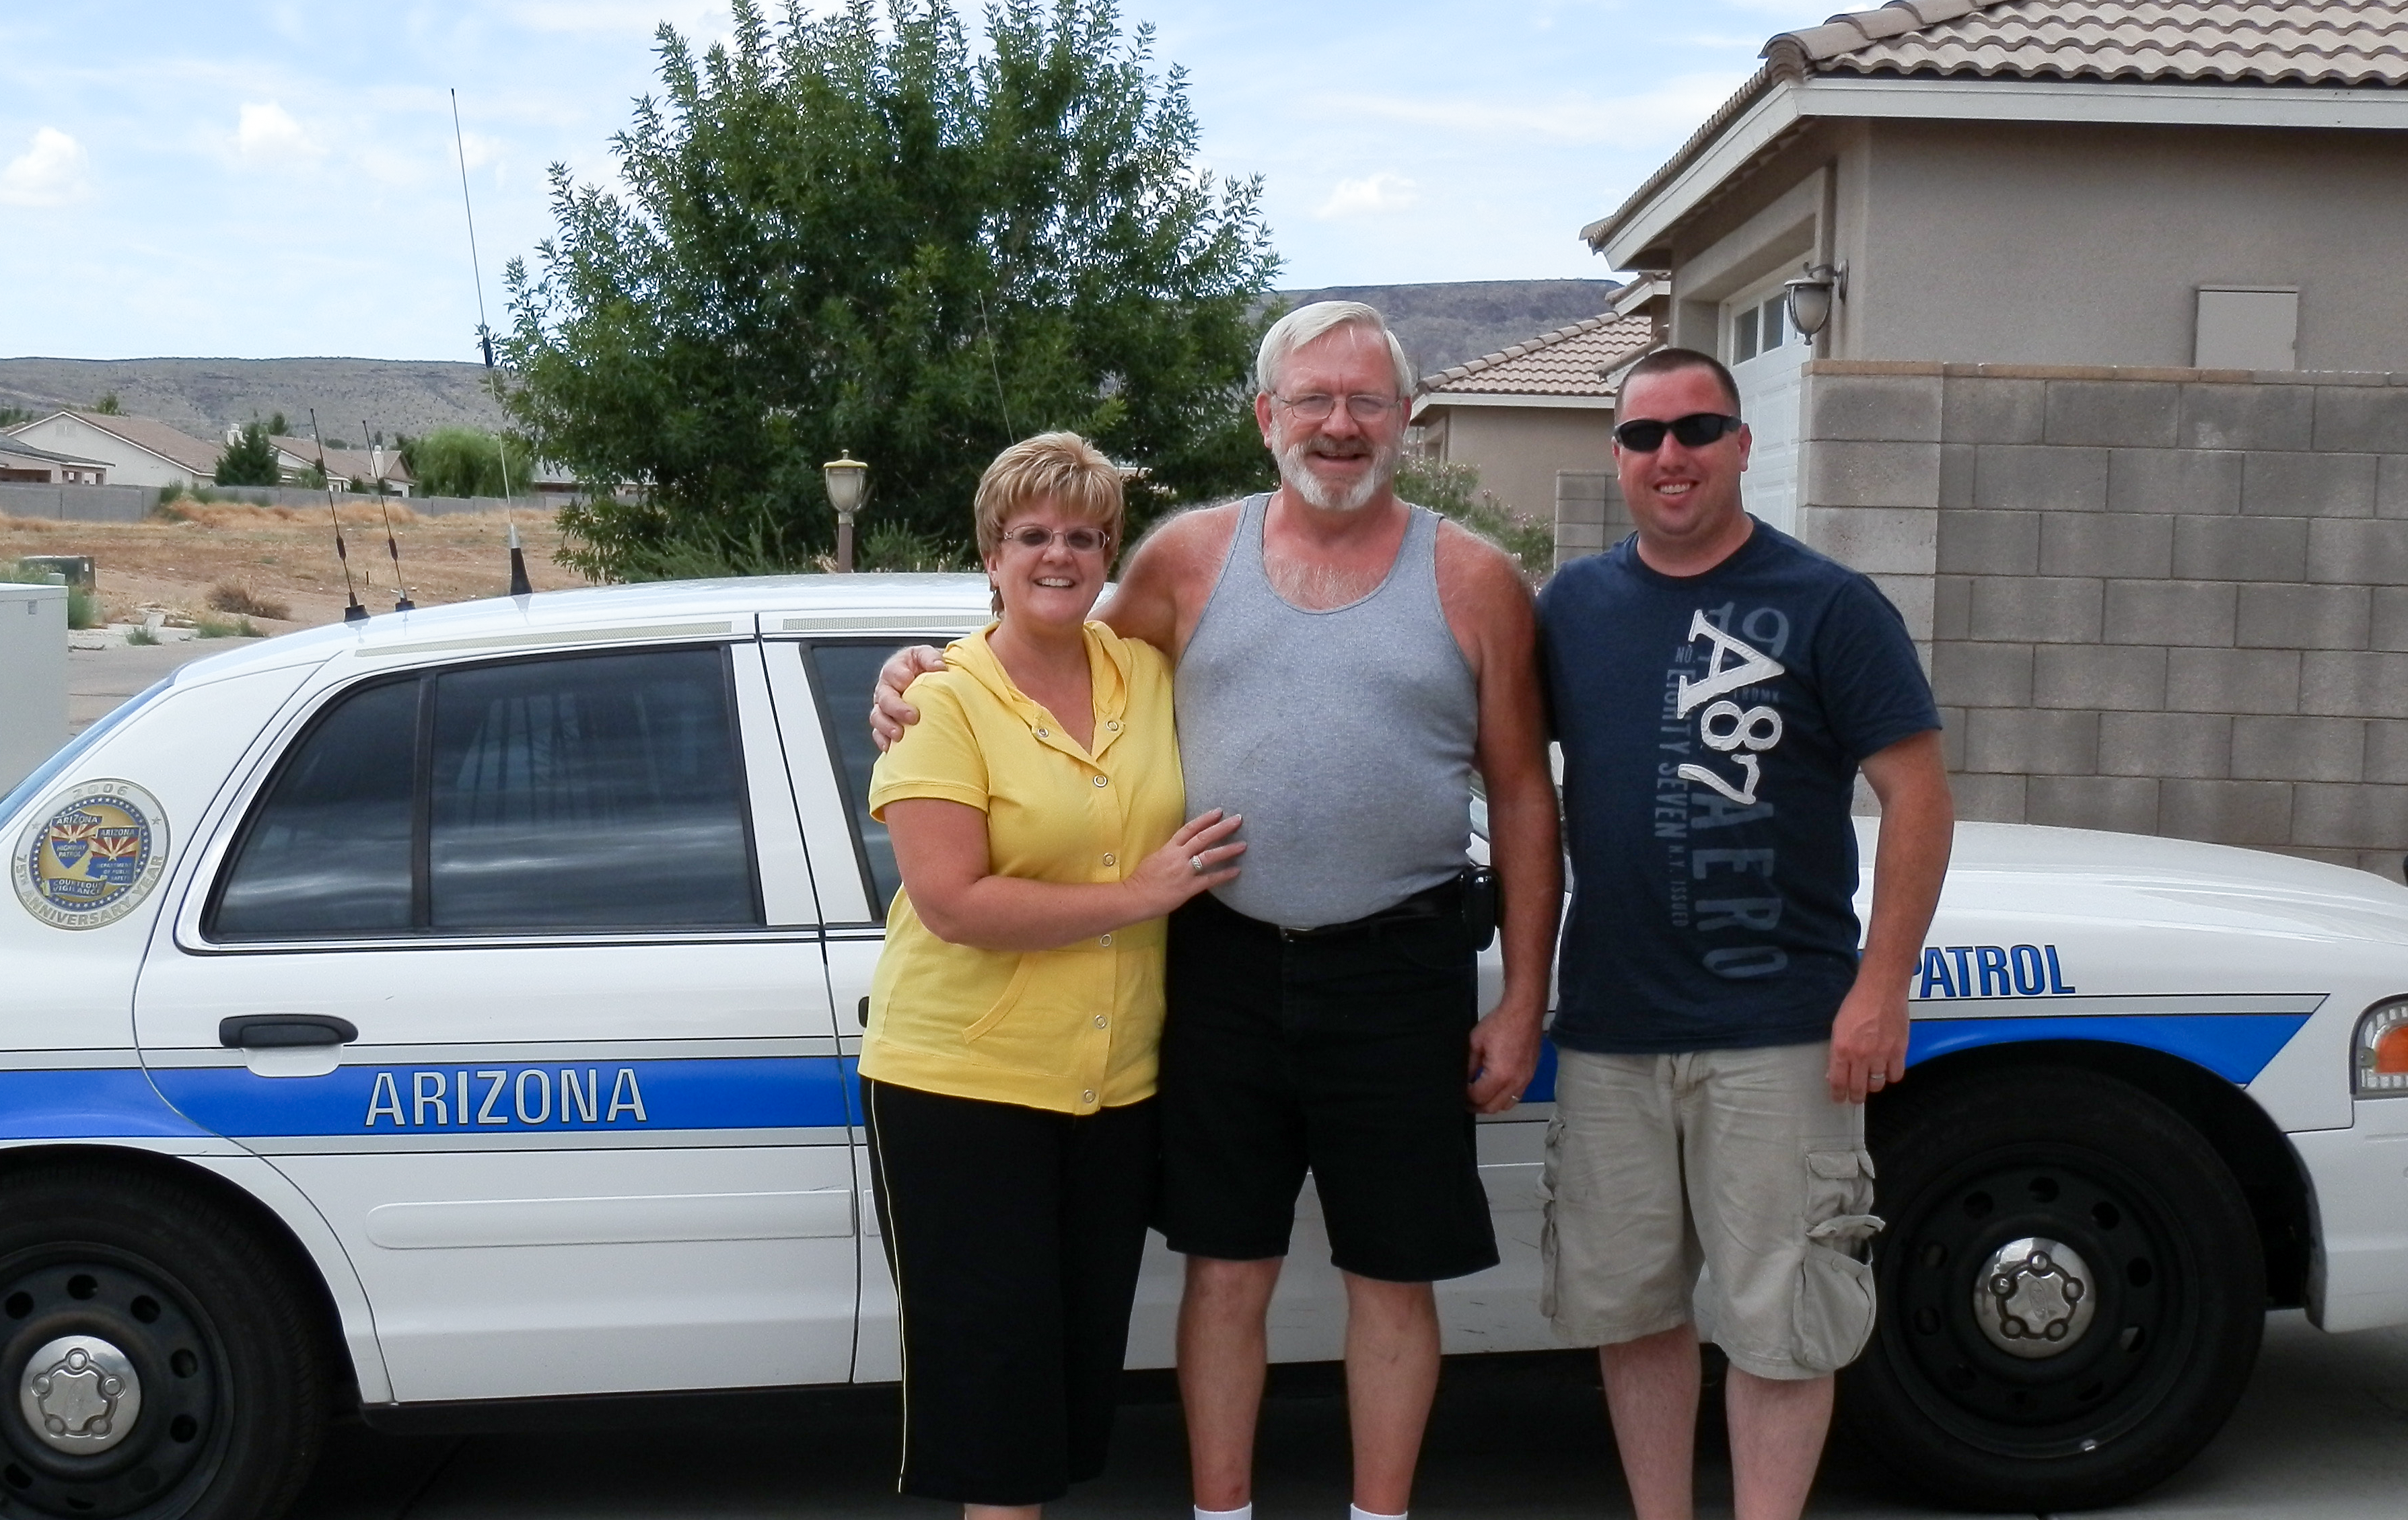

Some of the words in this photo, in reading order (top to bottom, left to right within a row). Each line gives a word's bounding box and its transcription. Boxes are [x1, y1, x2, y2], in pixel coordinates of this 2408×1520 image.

[72, 783, 129, 799] 2006
[1654, 762, 1689, 838] SEVEN
[57, 816, 98, 825] ARIZONA
[101, 828, 135, 836] ARIZONA
[22, 890, 131, 926] ANNIVERSARY
[132, 855, 164, 898] YEAR
[1670, 881, 1689, 927] ISSUED
[1691, 792, 1788, 979] AERO
[1914, 944, 2076, 999] ATROL
[364, 1067, 648, 1126] ARIZONA
